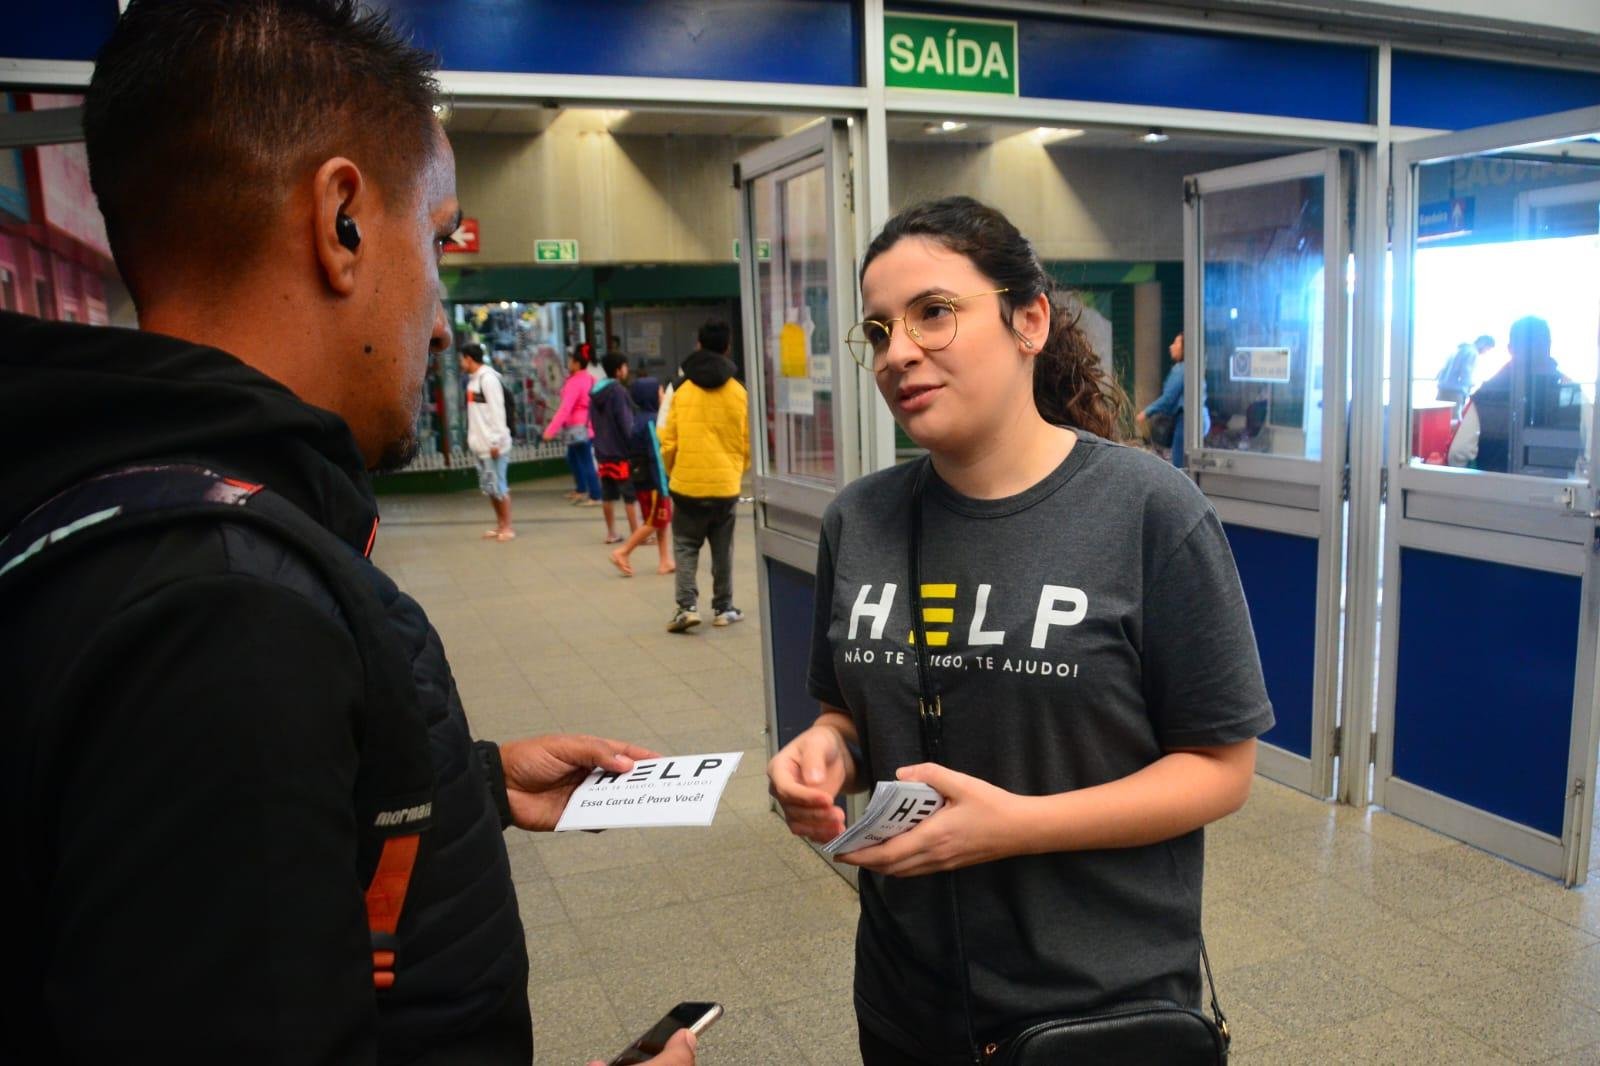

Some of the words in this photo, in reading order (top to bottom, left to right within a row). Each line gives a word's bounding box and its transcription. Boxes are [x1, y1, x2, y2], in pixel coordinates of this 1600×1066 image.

[890, 28, 1009, 79] SAÍDA
[847, 582, 1088, 649] HELP
[844, 648, 875, 664] NÃO
[885, 651, 905, 665] TE
[976, 656, 994, 670] TE
[1003, 659, 1079, 677] AJUDO!
[580, 799, 603, 808] Essa
[606, 796, 634, 806] Carta
[637, 793, 647, 804] É
[647, 796, 671, 804] Para
[675, 792, 704, 802] Você!
[888, 797, 937, 823] HE
